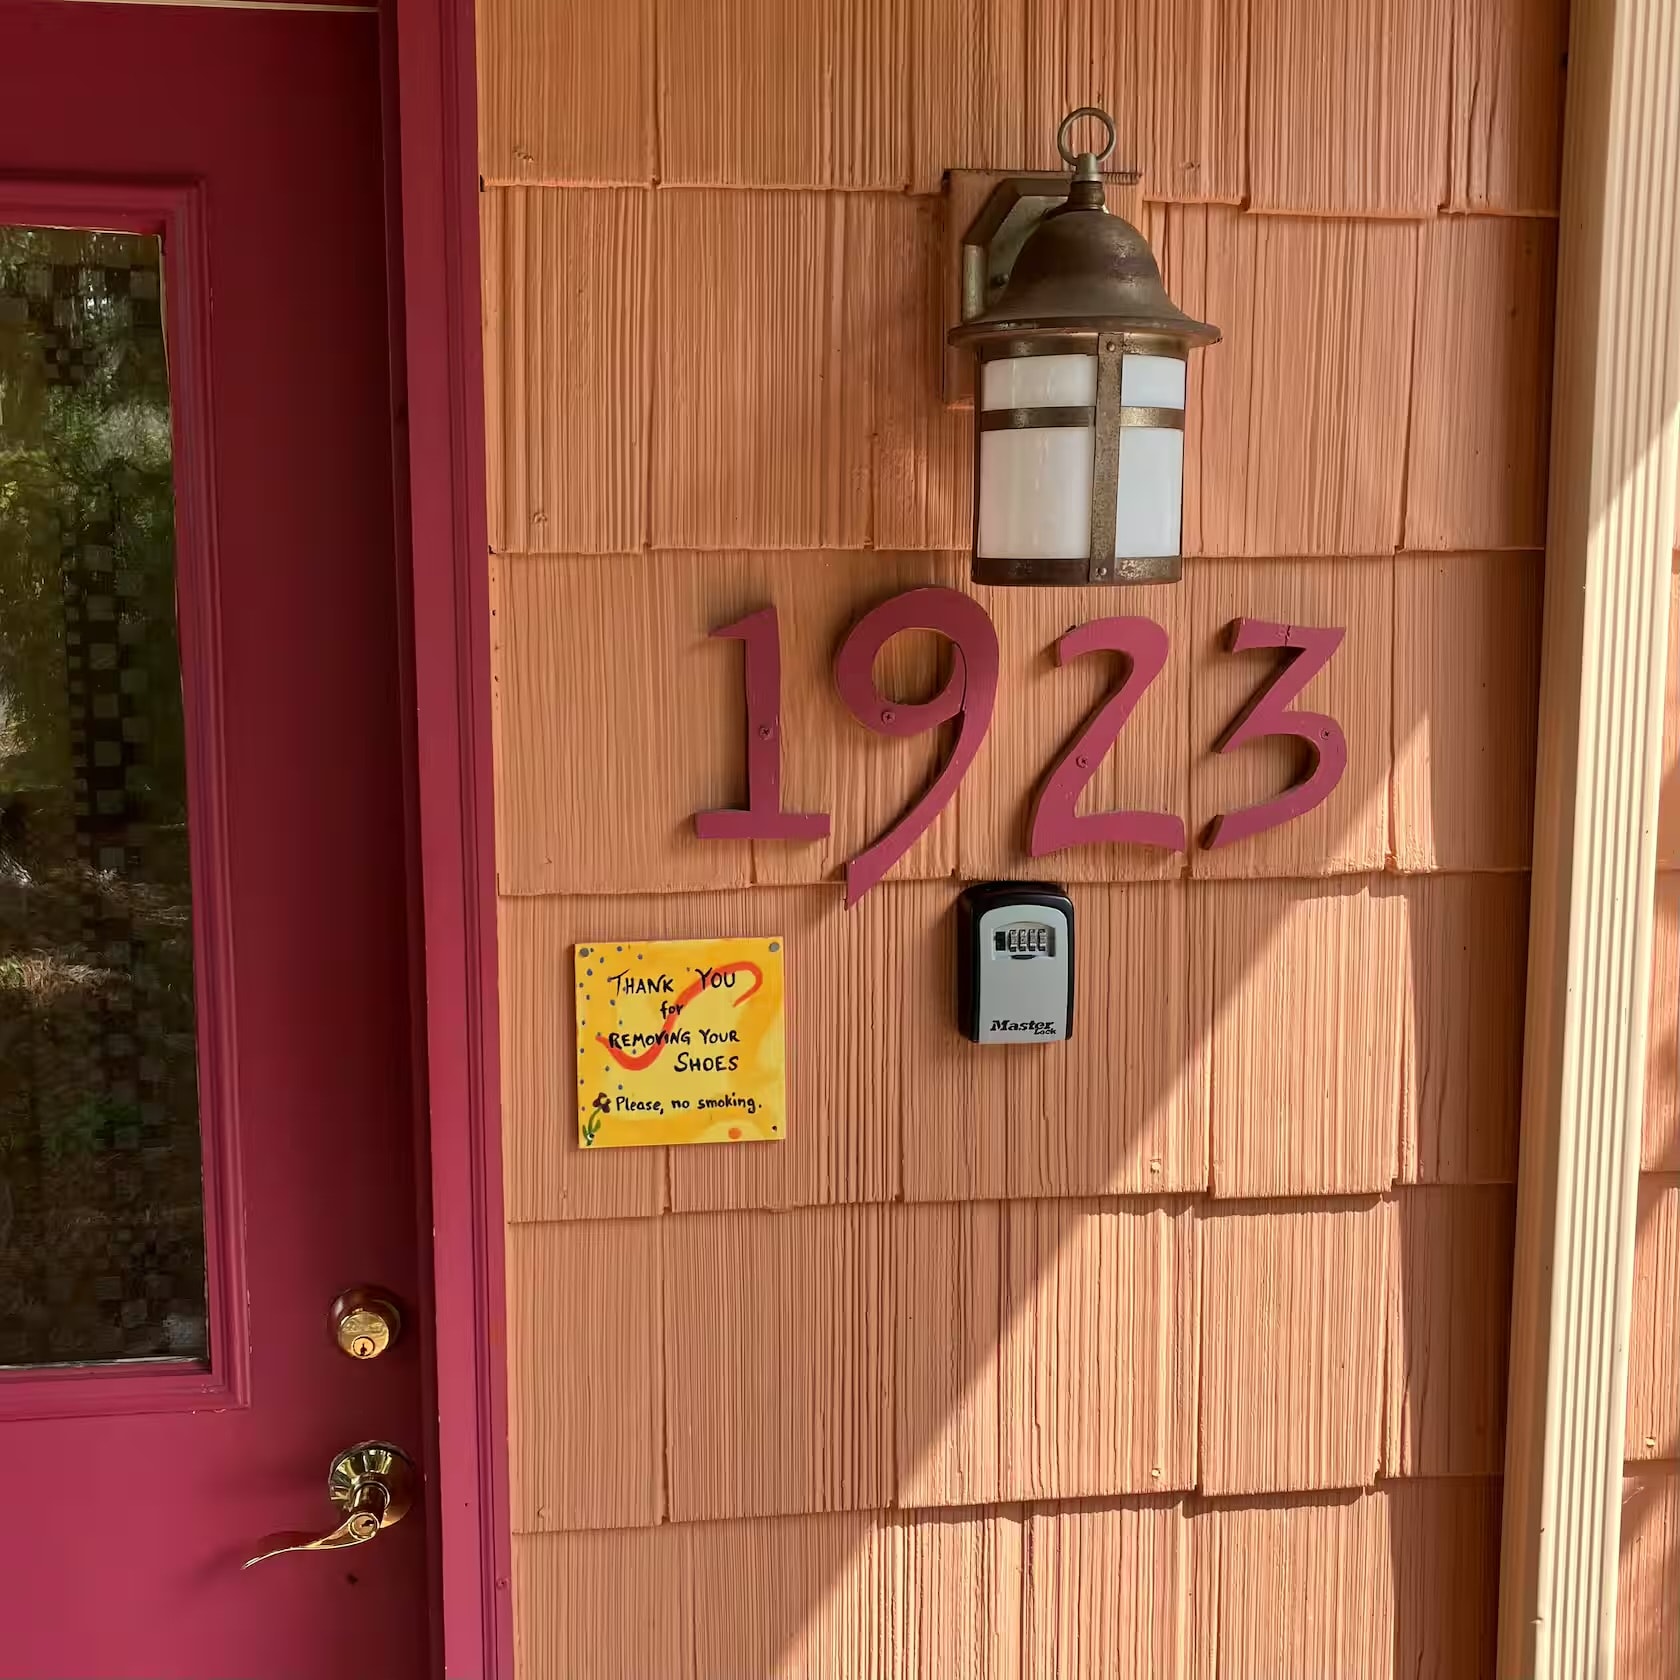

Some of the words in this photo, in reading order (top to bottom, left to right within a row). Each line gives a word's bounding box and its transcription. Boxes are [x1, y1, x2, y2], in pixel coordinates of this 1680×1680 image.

[692, 587, 1347, 911] 1923
[610, 969, 674, 996] THANK
[695, 967, 736, 989] YOU
[660, 1000, 684, 1019] for
[990, 1020, 1054, 1032] Master
[608, 1028, 691, 1049] REMOVING
[699, 1029, 740, 1044] YOUR
[674, 1052, 739, 1072] SHOES
[616, 1096, 664, 1114] Please,
[671, 1099, 690, 1109] no
[697, 1092, 762, 1114] smoking.
